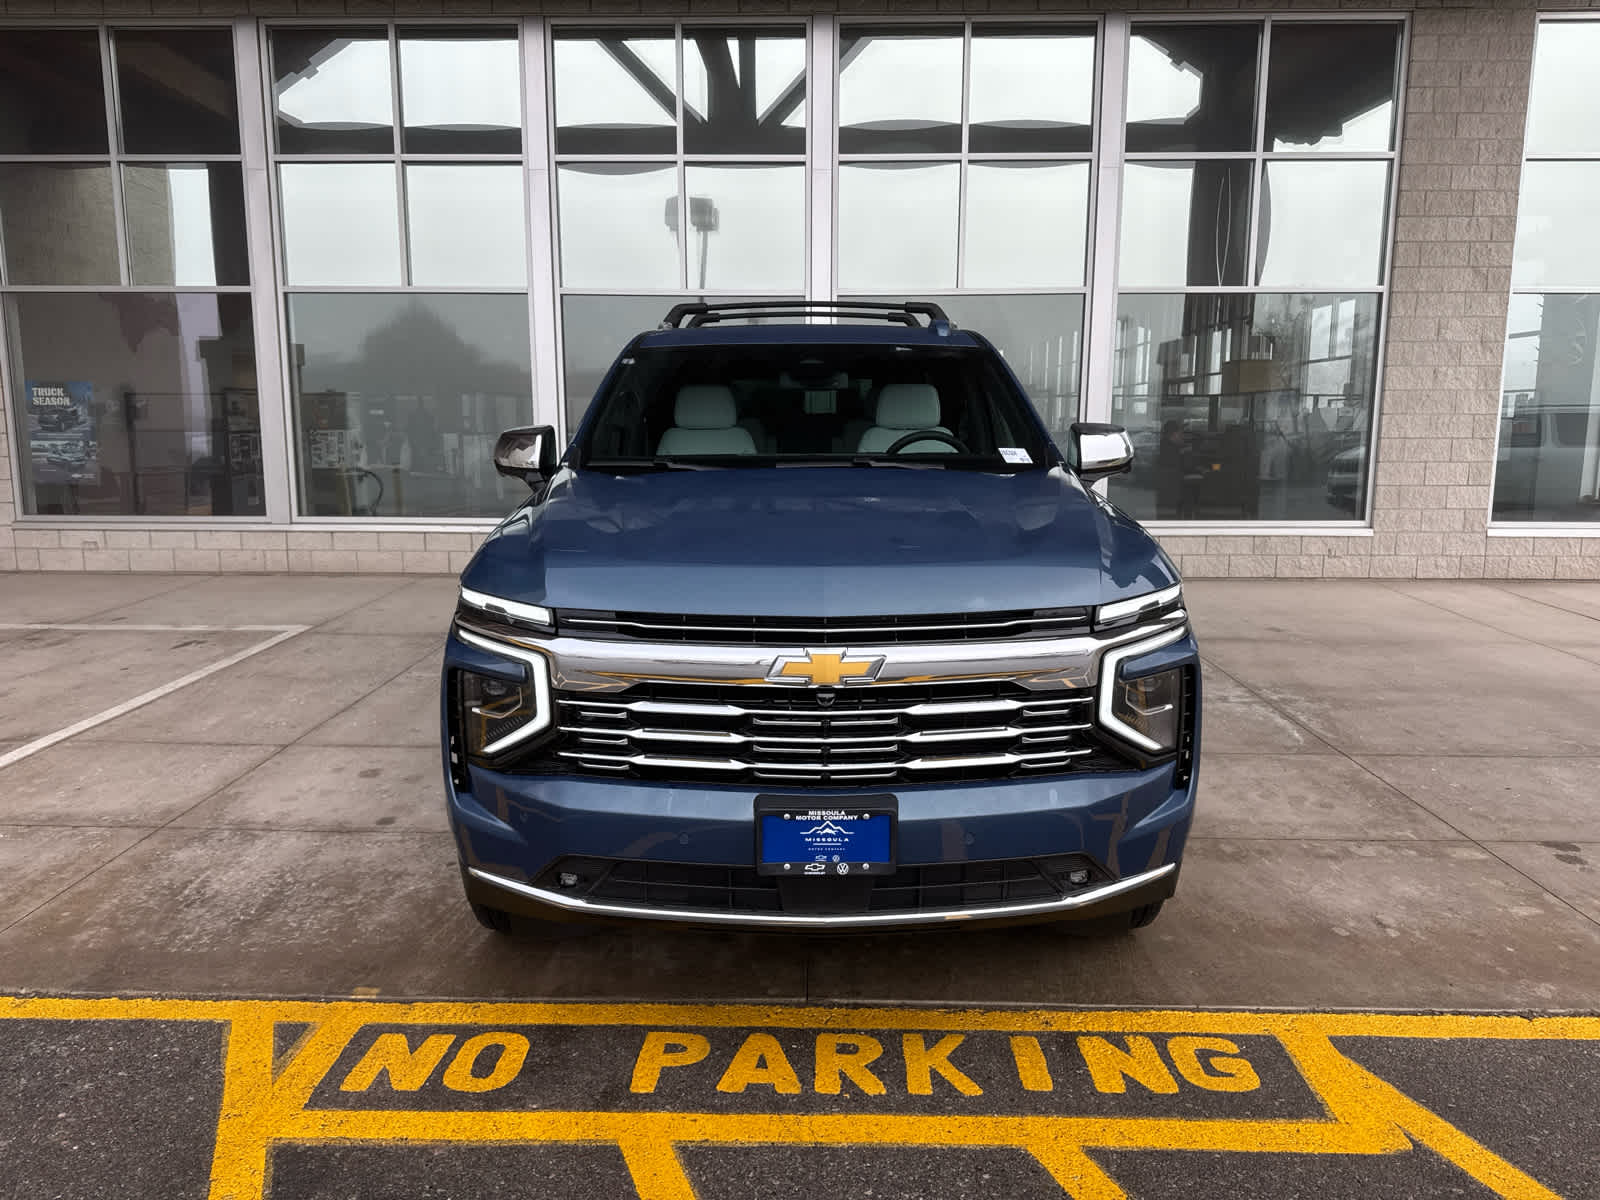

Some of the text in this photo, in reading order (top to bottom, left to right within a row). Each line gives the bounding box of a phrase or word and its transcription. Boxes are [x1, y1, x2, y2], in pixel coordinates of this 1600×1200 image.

[32, 387, 64, 396] TRUCK
[33, 397, 71, 406] SEASON
[339, 1031, 1261, 1096] NO PARKING
